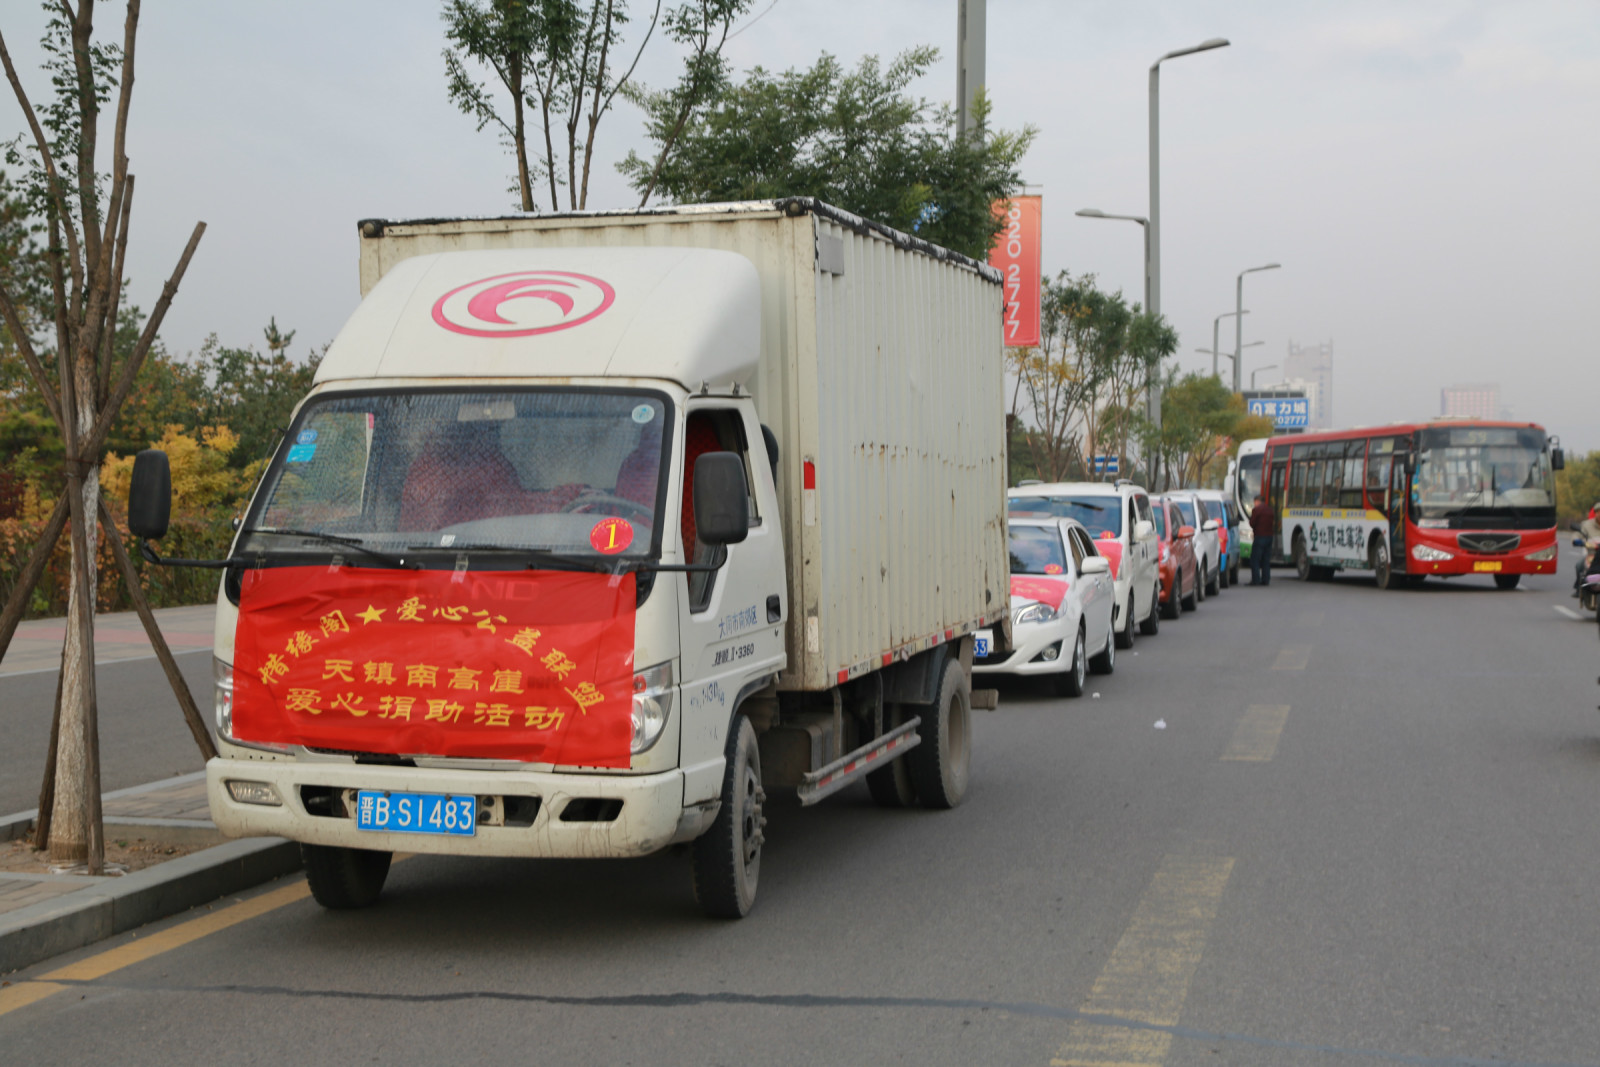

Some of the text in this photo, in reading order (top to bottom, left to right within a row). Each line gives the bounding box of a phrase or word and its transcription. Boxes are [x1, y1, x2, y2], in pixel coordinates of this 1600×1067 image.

[1007, 264, 1021, 339] 2777
[1264, 401, 1307, 416] 富力城
[1273, 415, 1307, 425] 02777
[603, 523, 620, 551] 1
[718, 604, 757, 639] 大同市南郊区
[397, 596, 604, 714] 爱心公益联盟
[322, 659, 525, 695] 天镇南高崖
[285, 688, 565, 731] 爱心捐助活动
